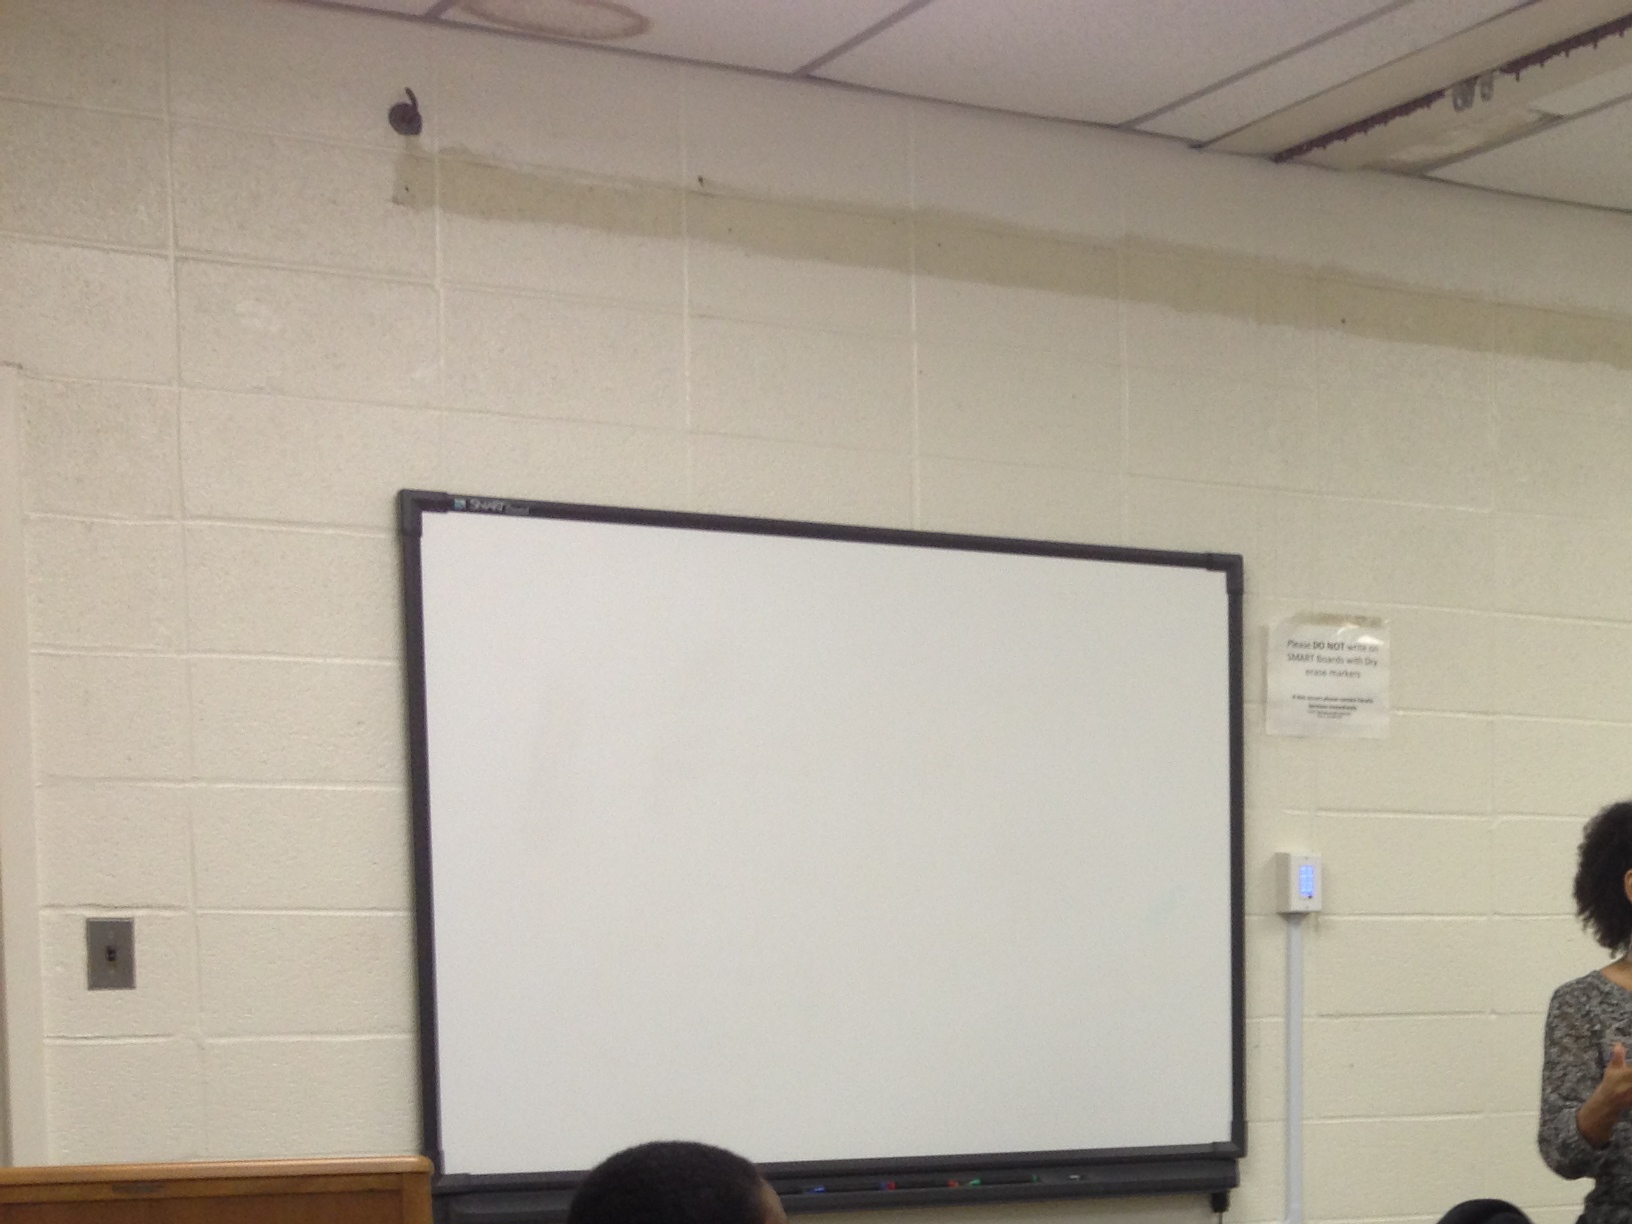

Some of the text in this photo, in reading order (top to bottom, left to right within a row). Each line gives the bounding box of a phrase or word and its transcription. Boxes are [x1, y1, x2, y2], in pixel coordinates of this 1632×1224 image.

[1287, 639, 1311, 650] Please
[1313, 641, 1325, 650] DO
[1327, 642, 1344, 651] NOT
[1347, 643, 1366, 652] write
[1287, 653, 1378, 667] SMART Boards with Dry
[1305, 669, 1327, 677] erase
